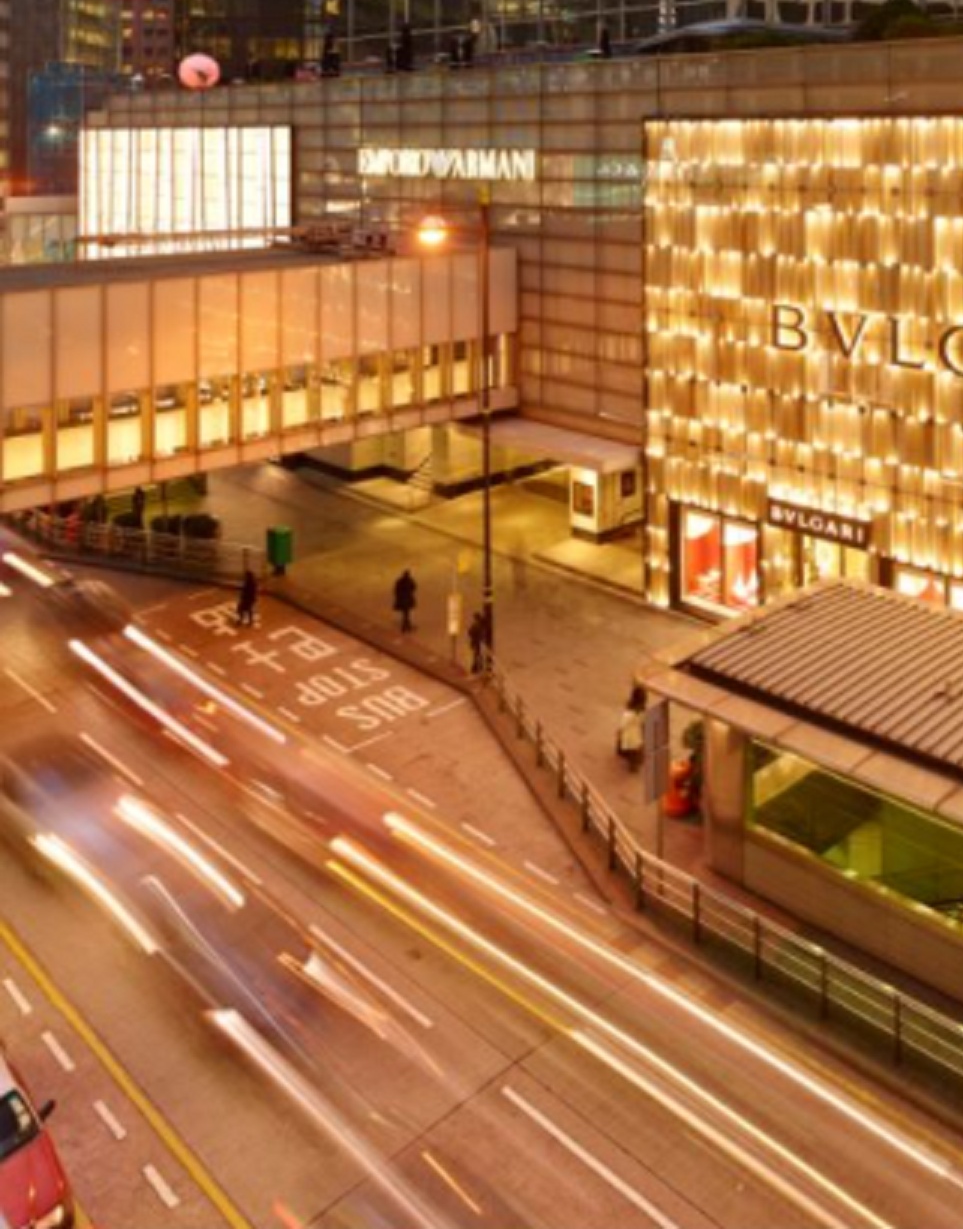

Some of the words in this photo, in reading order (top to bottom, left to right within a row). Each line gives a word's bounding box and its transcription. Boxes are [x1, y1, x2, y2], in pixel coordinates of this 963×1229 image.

[452, 148, 536, 180] ARMANI
[769, 504, 864, 544] BVLGARI
[295, 657, 390, 707] STOP
[335, 684, 430, 731] BUS
